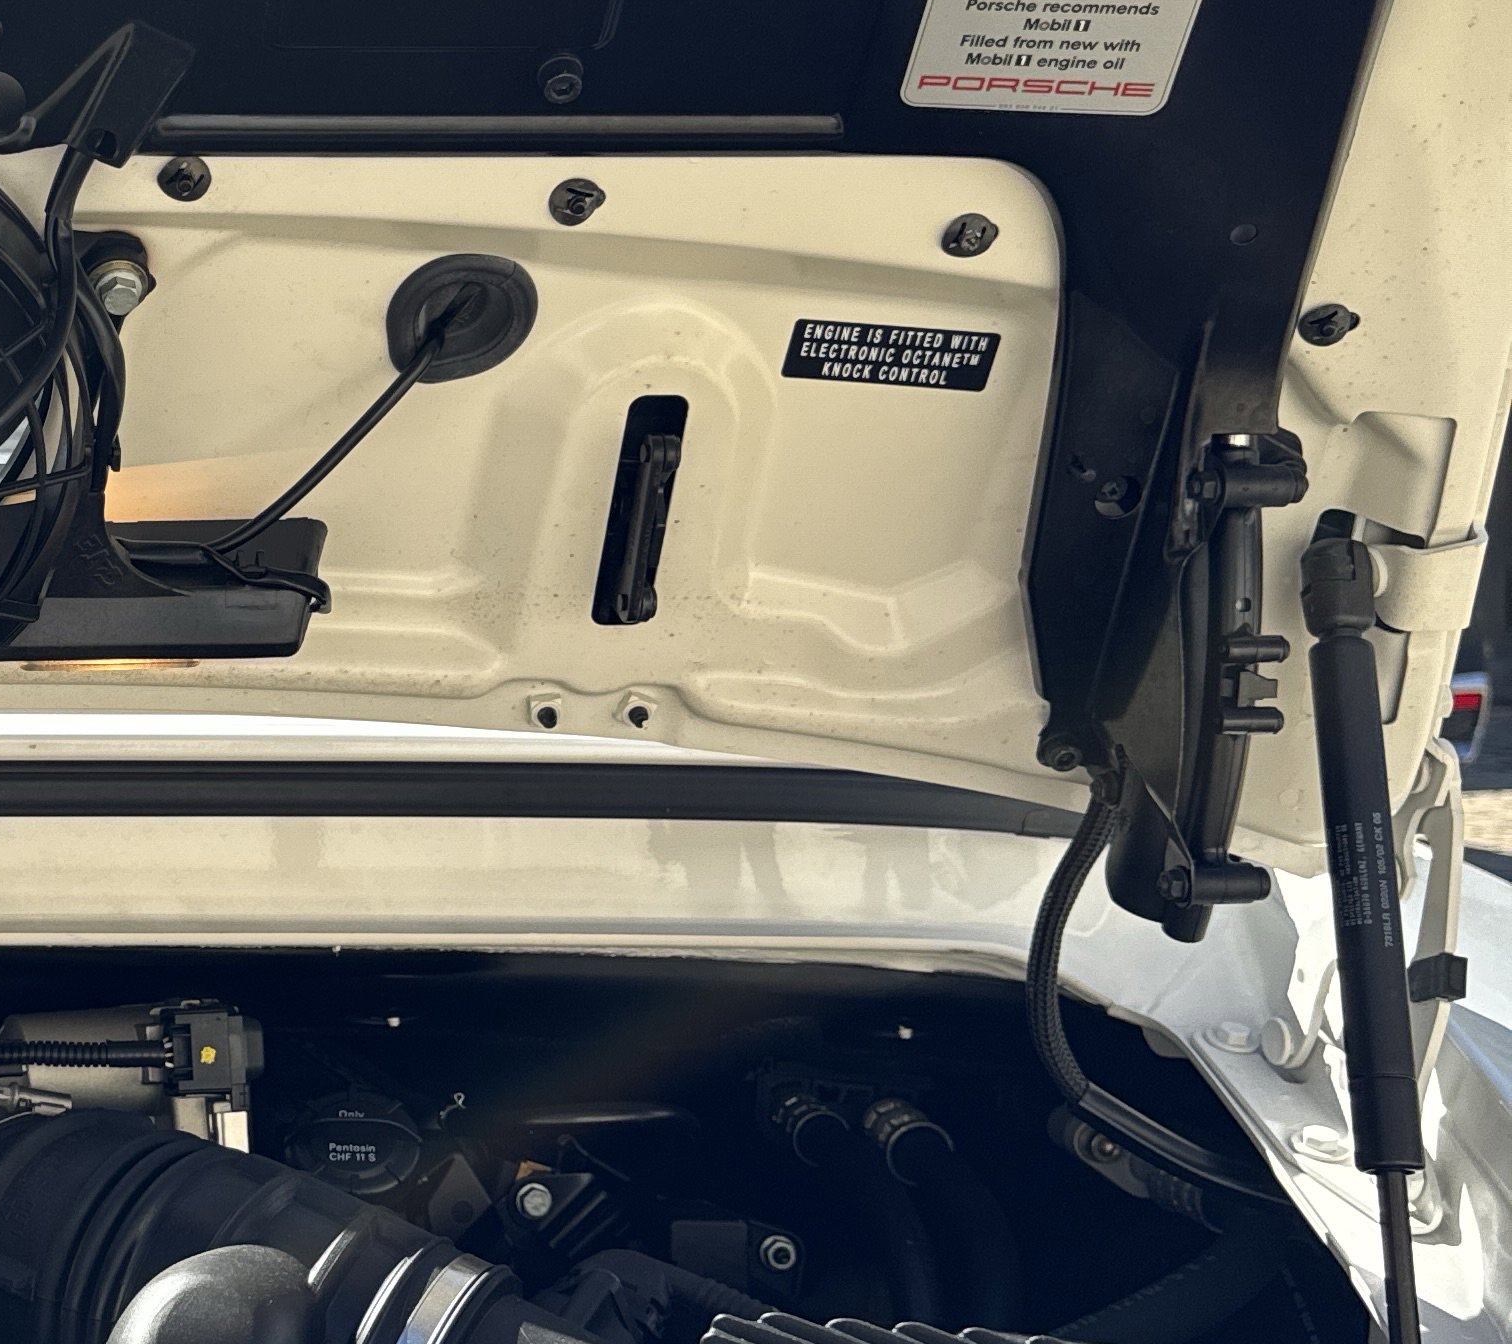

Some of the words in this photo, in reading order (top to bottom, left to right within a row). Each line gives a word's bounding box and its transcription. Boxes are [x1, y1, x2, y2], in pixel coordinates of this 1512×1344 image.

[1042, 0, 1160, 16] recommends
[1023, 18, 1071, 32] Mobil
[960, 34, 1008, 49] Filled
[1012, 36, 1055, 50] from
[1059, 40, 1097, 51] new
[1103, 39, 1141, 52] with
[964, 53, 1012, 67] Mobil
[1037, 57, 1097, 71] engine
[1103, 56, 1125, 71] oil
[917, 75, 1156, 97] PORSCHE
[803, 323, 861, 342] ENGINE
[866, 328, 883, 344] IS
[888, 330, 943, 348] FITTED
[950, 335, 989, 352] WITH
[800, 342, 897, 364] ELECTRONIC
[821, 362, 874, 380] KNOCK
[878, 367, 948, 385] CONTROL
[328, 1142, 376, 1153] Pentosin
[328, 1152, 352, 1162] CHF
[355, 1152, 365, 1162] 11
[368, 1152, 377, 1163] S
